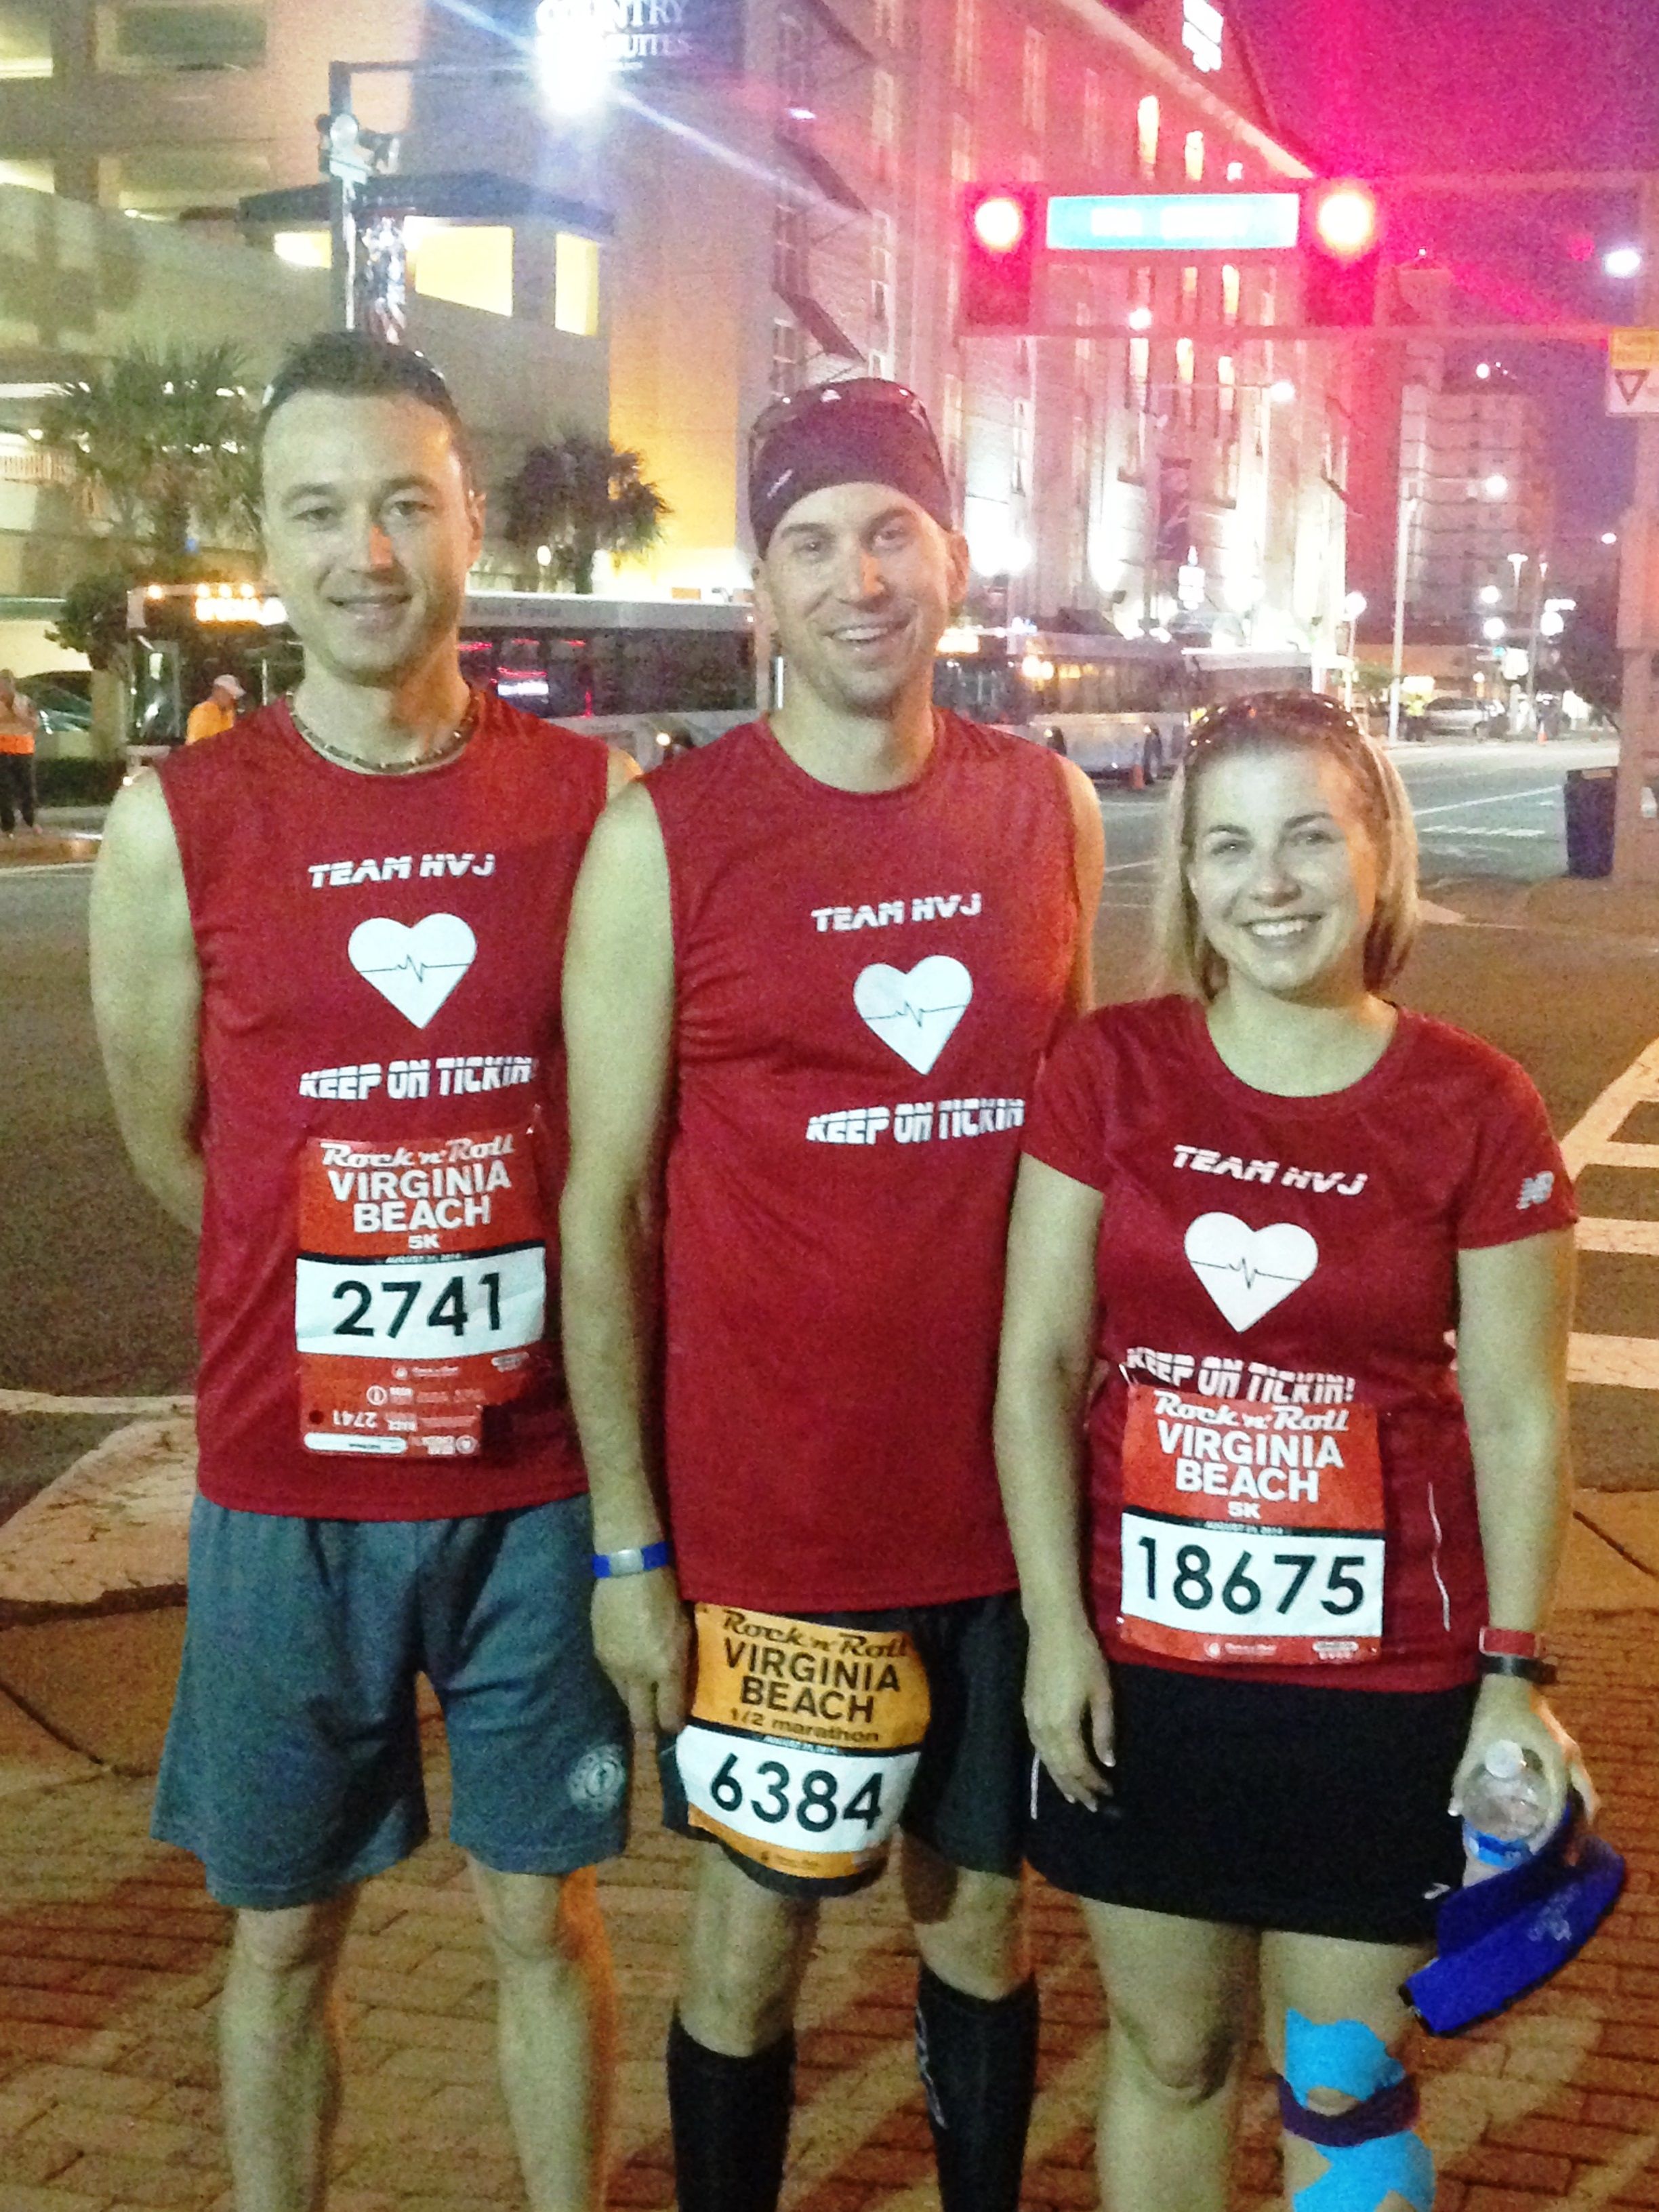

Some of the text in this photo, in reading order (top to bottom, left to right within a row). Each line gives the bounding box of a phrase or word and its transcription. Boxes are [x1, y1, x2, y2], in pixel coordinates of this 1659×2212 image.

[308, 853, 495, 888] TEAM HVJ
[811, 892, 981, 933] TEAM HVJ
[299, 1063, 382, 1100] KEEP
[387, 1059, 430, 1099] ON
[806, 1106, 890, 1145] KEEP
[893, 1101, 934, 1143] ON
[320, 1141, 415, 1168] Rock
[445, 1134, 515, 1163] Roll
[1173, 1144, 1368, 1197] TEAM HVJ
[327, 1160, 511, 1202] VIRGINIA
[354, 1195, 491, 1233] BEACH
[408, 1234, 441, 1250] 5K
[332, 1272, 501, 1339] 2741
[1126, 1346, 1356, 1405] KEEP ON TICKIN!
[332, 1410, 377, 1429] 2741
[1153, 1389, 1240, 1427] Rock
[1271, 1404, 1349, 1431] Roll
[1157, 1420, 1345, 1469] VIRGINIA
[1176, 1458, 1319, 1503] BEACH
[1227, 1502, 1261, 1519] 5K
[1137, 1536, 1366, 1616] 18675
[722, 1610, 804, 1647] Rock
[838, 1632, 908, 1658] Roll
[724, 1637, 901, 1693] VIRGINIA
[740, 1675, 874, 1723] BEACH
[730, 1707, 879, 1742] 1/2 marathon
[710, 1752, 884, 1833] 6384
